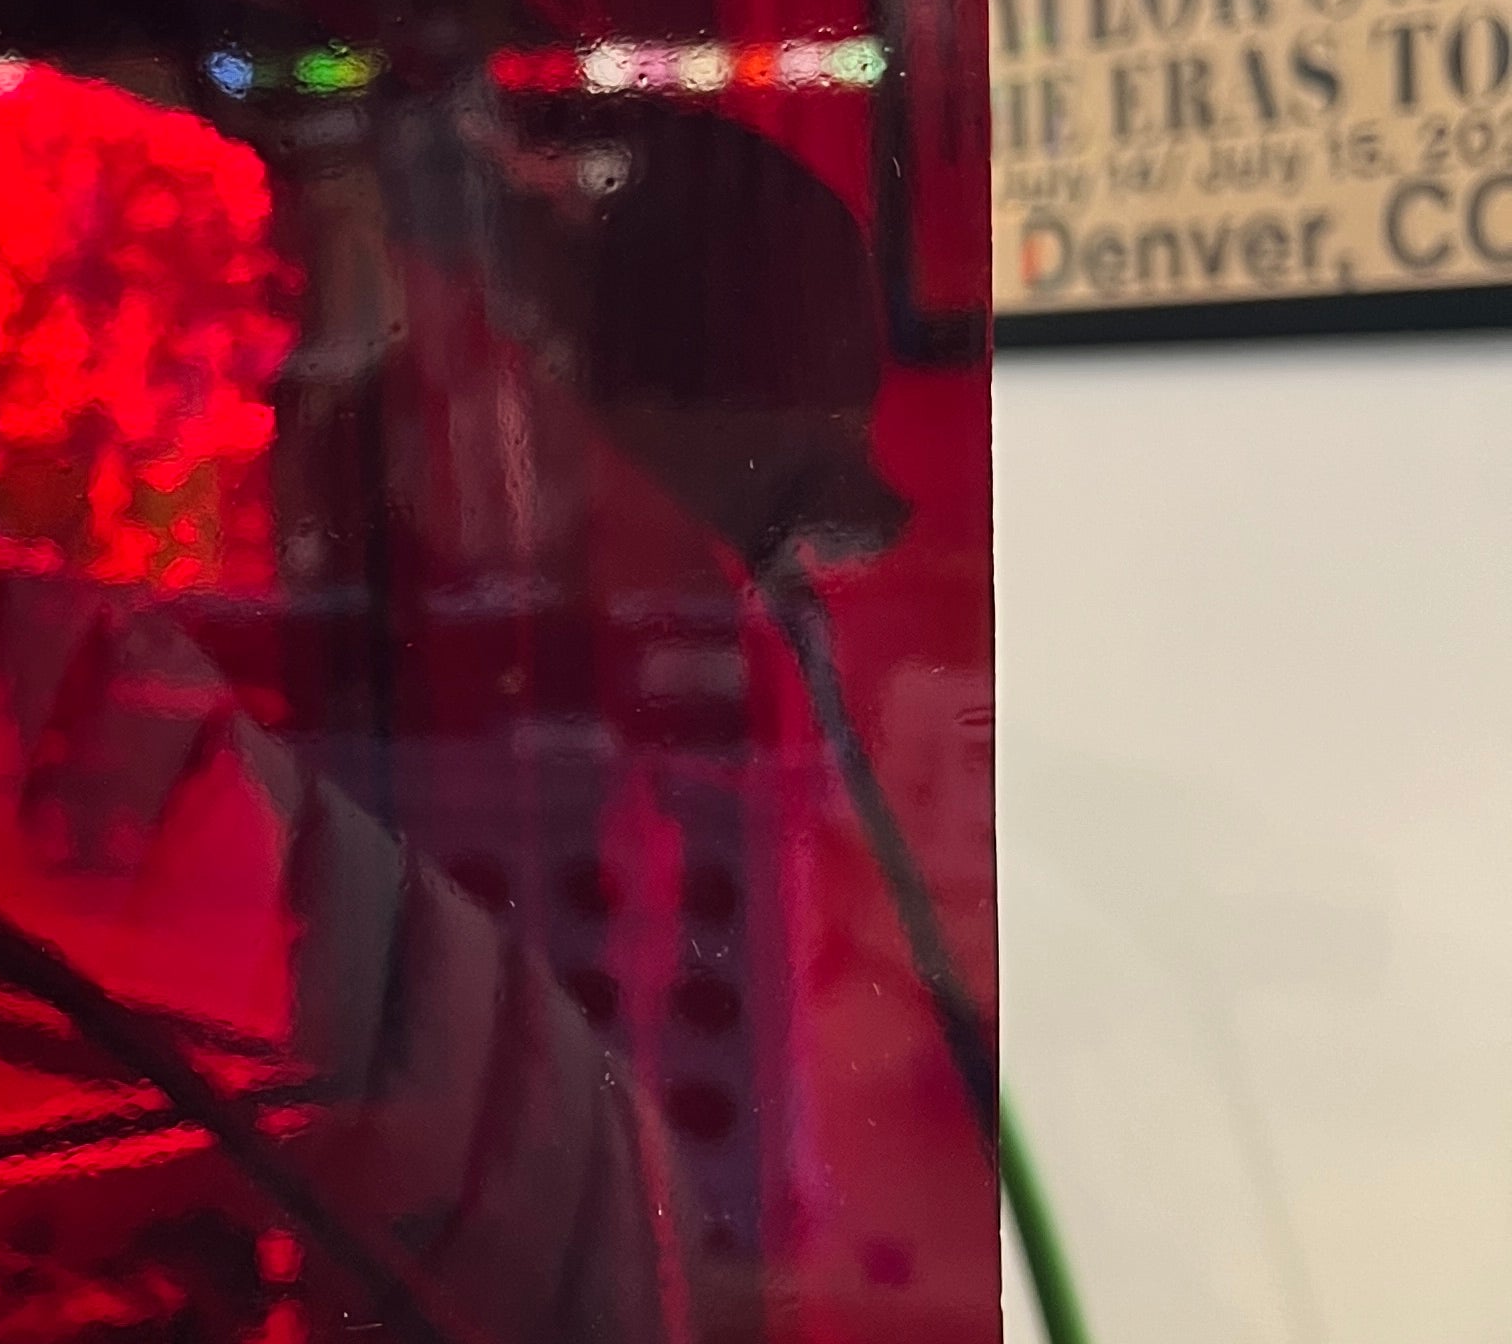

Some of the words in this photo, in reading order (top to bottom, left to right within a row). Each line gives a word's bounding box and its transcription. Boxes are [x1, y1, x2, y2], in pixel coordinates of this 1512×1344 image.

[1108, 28, 1344, 144] ERAS
[1192, 138, 1306, 204] July
[1022, 204, 1354, 296] Denver,
